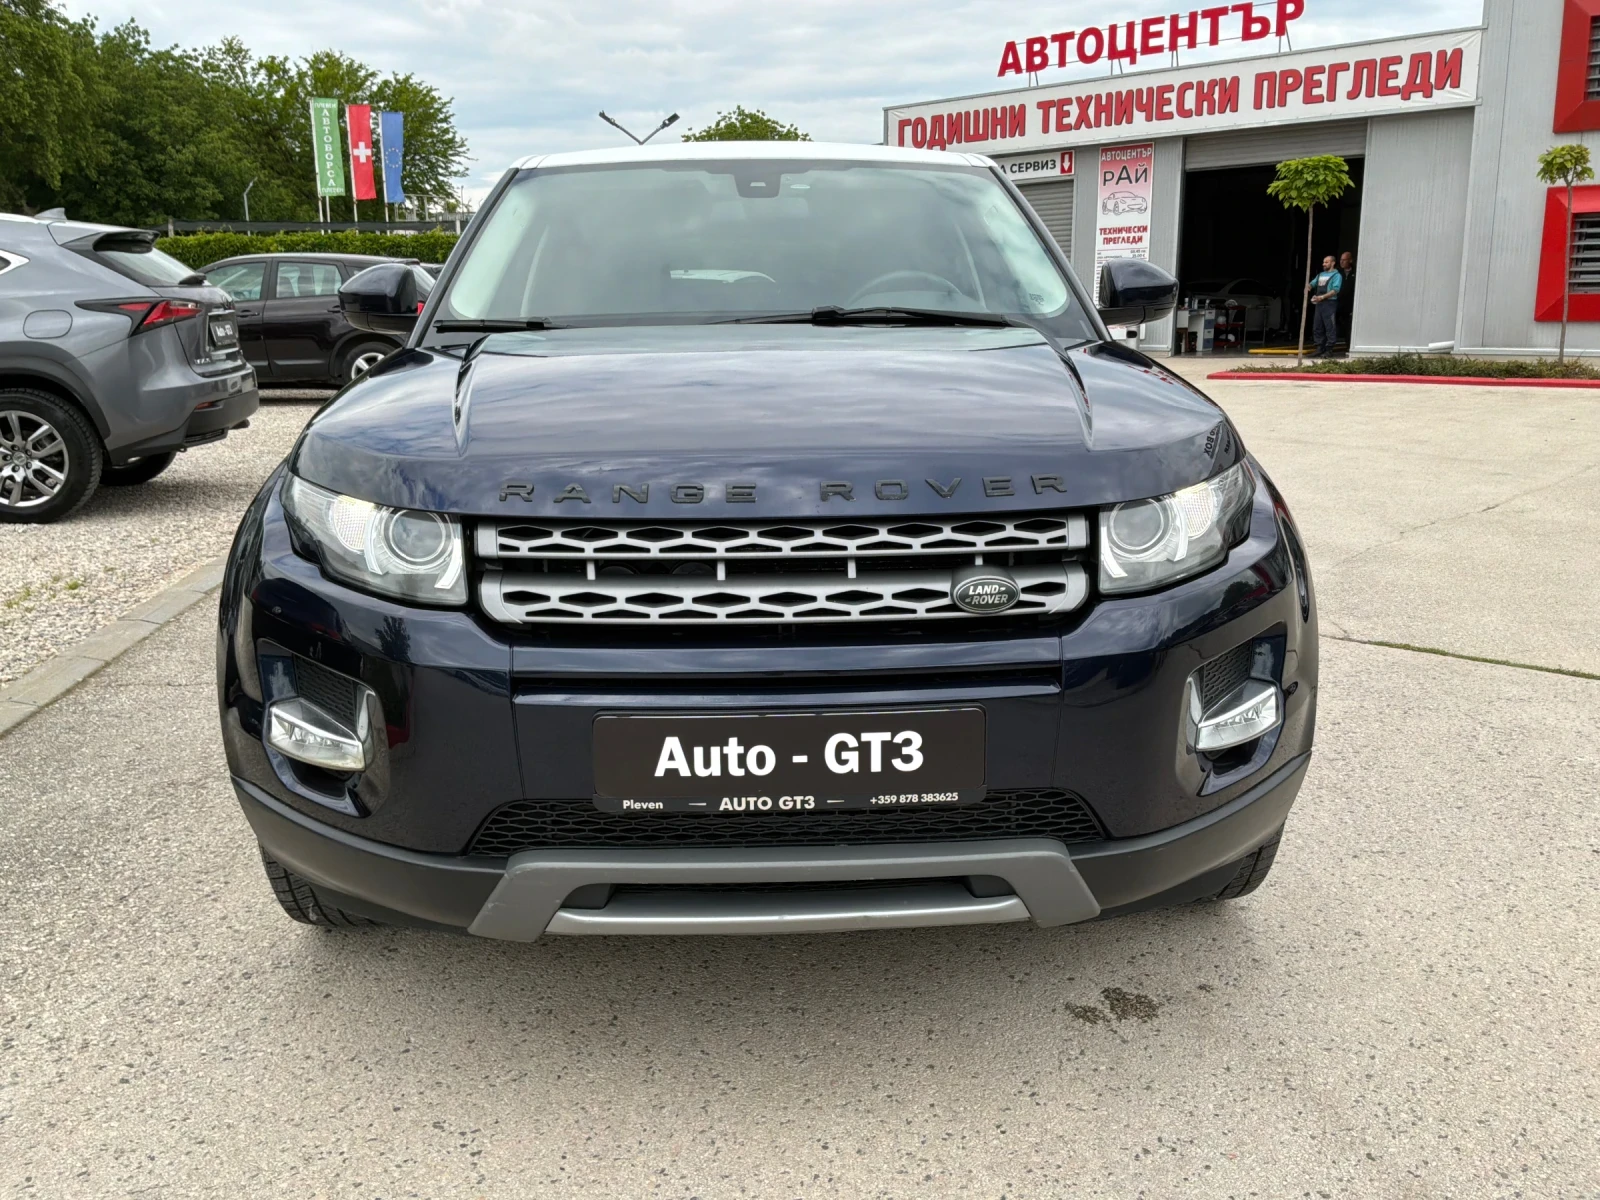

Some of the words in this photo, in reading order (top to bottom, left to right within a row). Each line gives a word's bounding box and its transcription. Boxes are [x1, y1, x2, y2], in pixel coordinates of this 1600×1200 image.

[997, 0, 1305, 77] АВТОЦЕНТЪР
[898, 104, 1027, 150] ГОДИШНИ
[1037, 76, 1240, 134] ТЕХНИЧЕСКИ
[1253, 48, 1463, 110] ПРЕГЛЕДИ
[322, 108, 336, 187] АВТОБОРСА
[1101, 147, 1152, 161] АВТОЦЕНТЪР
[1009, 159, 1057, 174] СЕРВИЗ
[1103, 163, 1148, 187] РАЙ
[1099, 225, 1148, 236] ТЕХНИЧЕСКИ
[1102, 235, 1143, 245] ПРЕГЛЕДИ
[499, 482, 757, 504] RANGE
[820, 473, 1068, 502] ROVER
[969, 585, 999, 595] LAND
[971, 594, 1008, 605] ROVER
[654, 735, 776, 778] Auto
[824, 730, 924, 774] GT3
[622, 799, 664, 810] Pleven
[719, 797, 773, 811] AUTO
[778, 796, 815, 810] GT3
[869, 795, 898, 805] +359
[899, 794, 919, 804] 878
[920, 792, 959, 803] 383625
